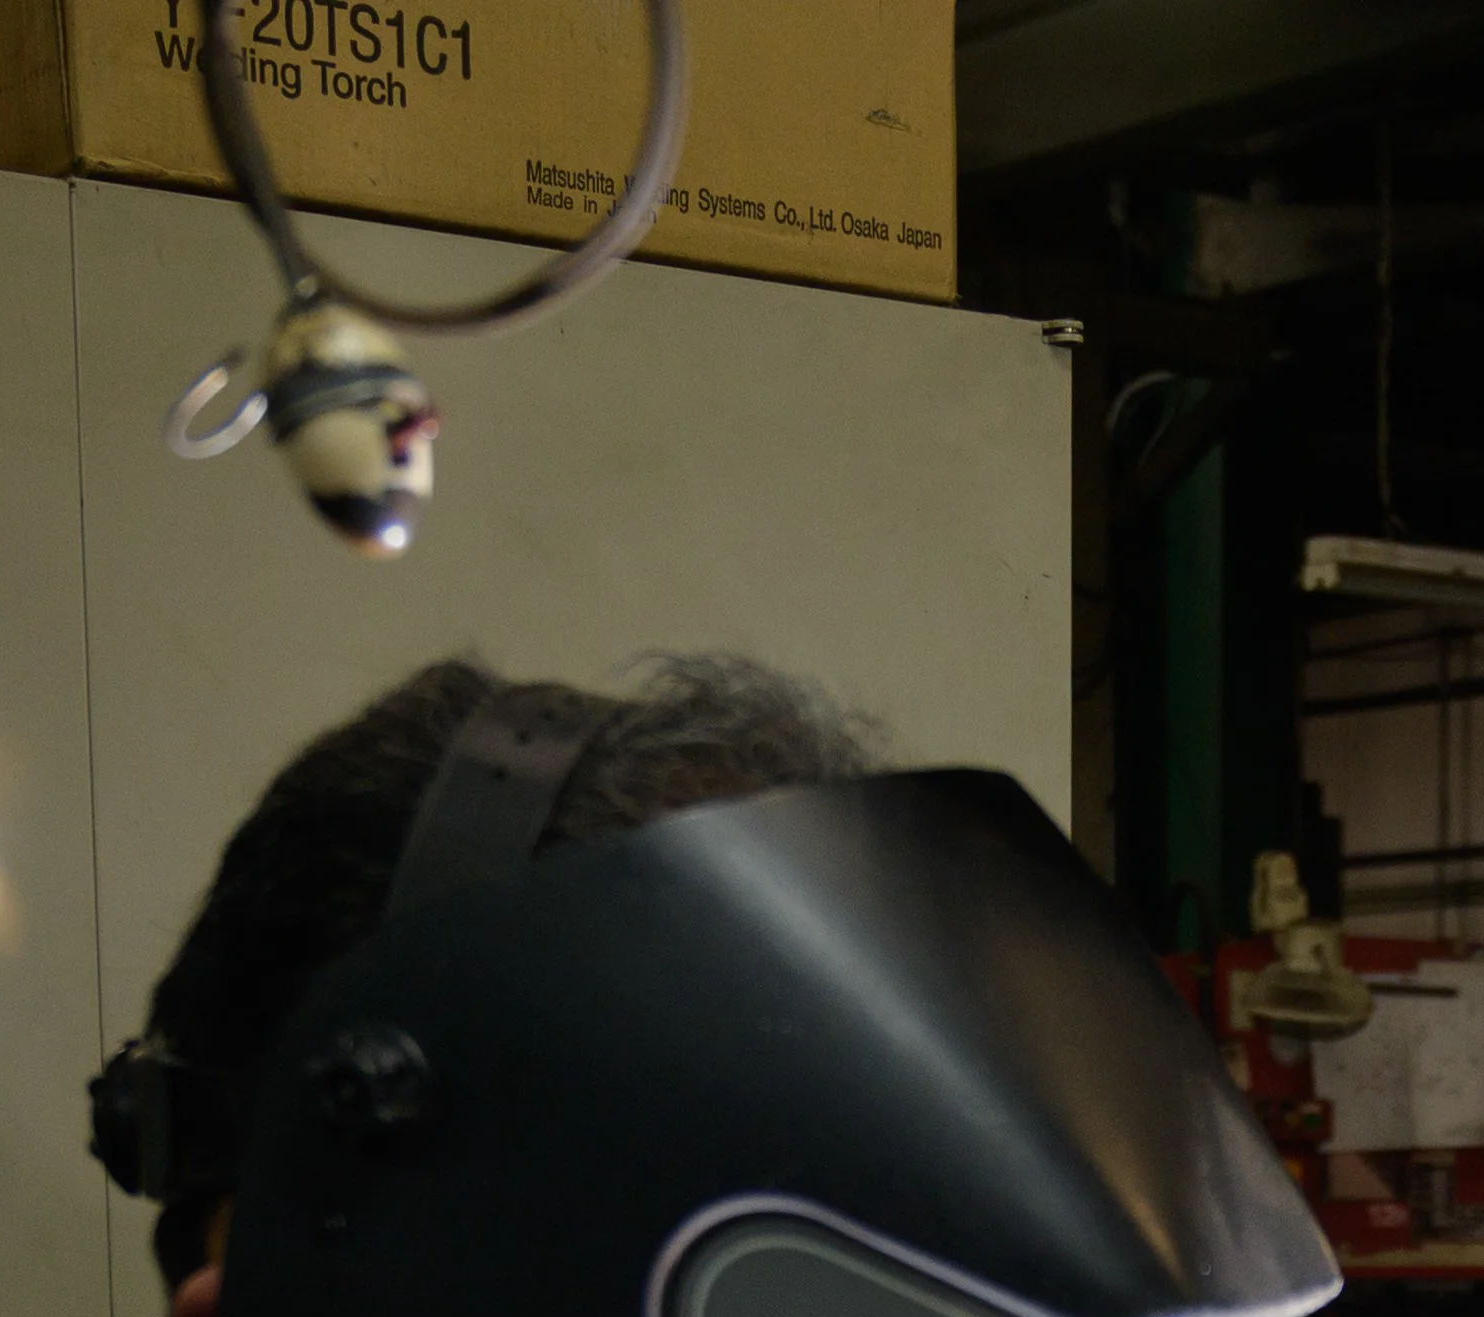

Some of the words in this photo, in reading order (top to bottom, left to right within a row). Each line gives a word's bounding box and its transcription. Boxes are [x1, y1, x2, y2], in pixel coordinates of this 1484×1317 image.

[155, 30, 302, 99] Wding
[312, 59, 407, 107] Torch
[526, 159, 615, 196] Matsushita
[698, 188, 765, 221] Systems
[810, 206, 837, 232] Ltd.
[841, 211, 889, 241] Osaka
[897, 222, 942, 250] Japan
[527, 186, 573, 211] Made
[584, 195, 598, 214] in
